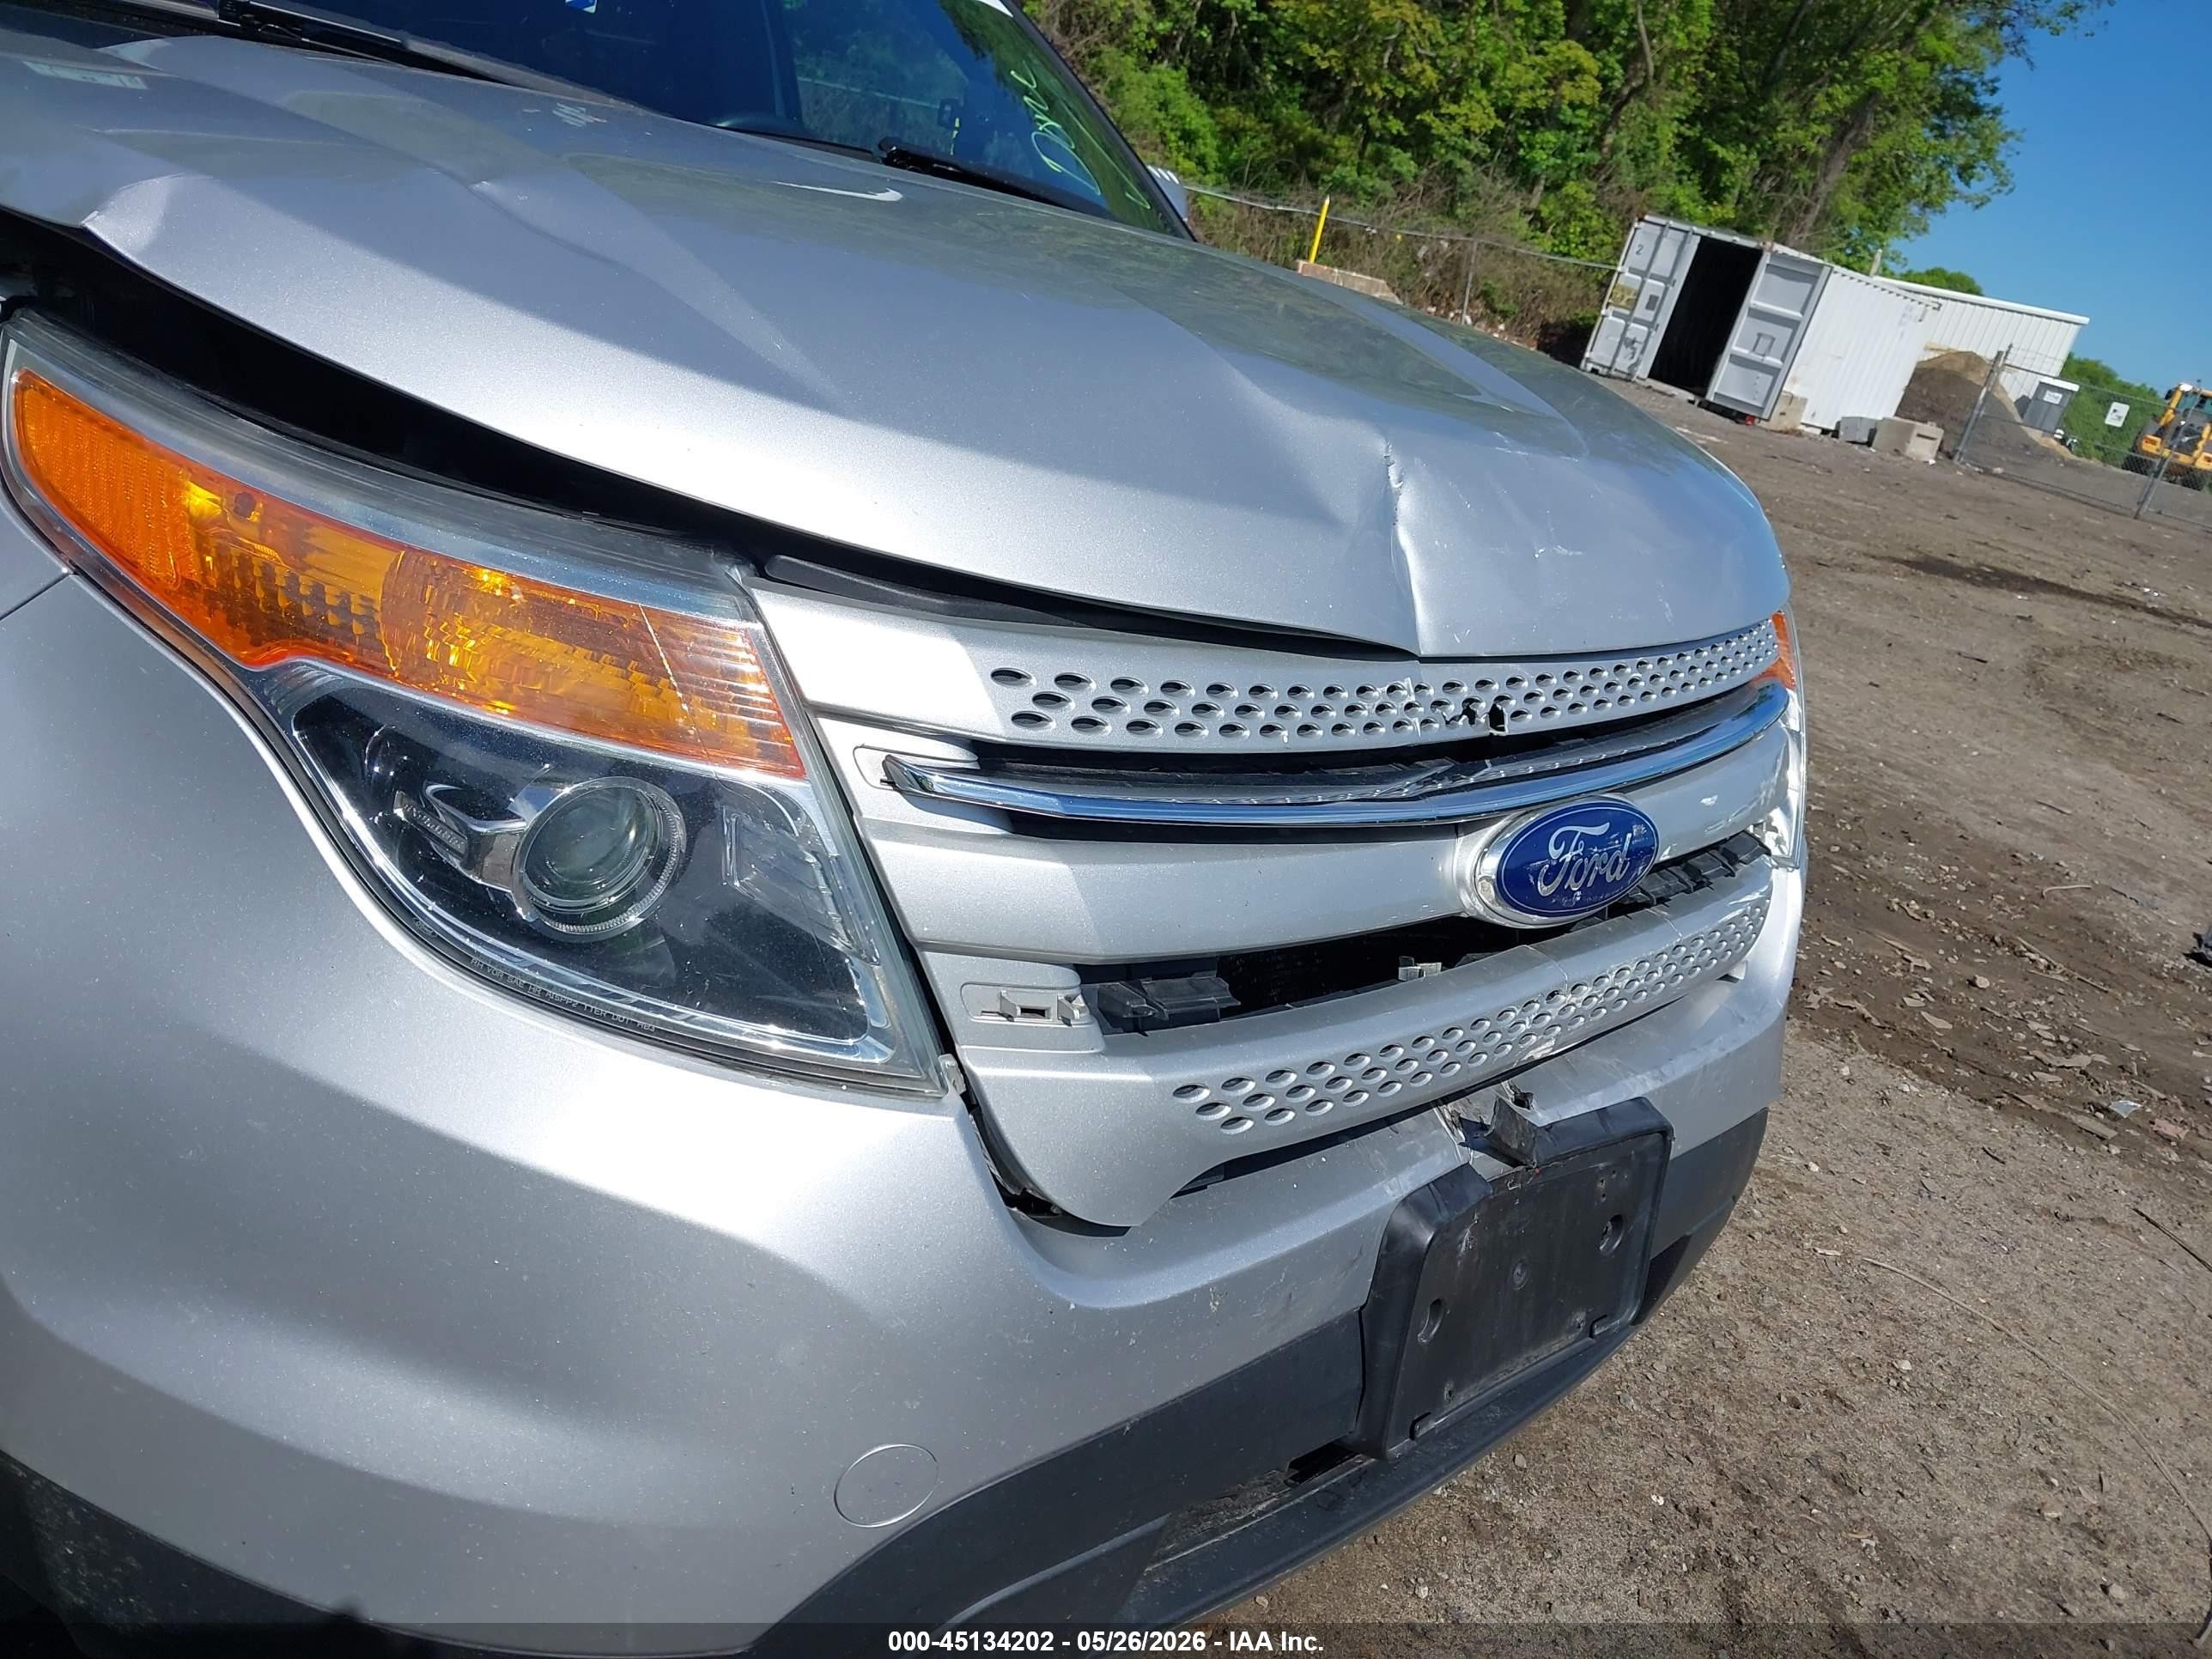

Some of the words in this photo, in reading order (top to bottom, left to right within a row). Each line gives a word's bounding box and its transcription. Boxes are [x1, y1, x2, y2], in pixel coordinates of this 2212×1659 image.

[1635, 243, 1644, 256] 2
[1537, 821, 1632, 897] Ford
[471, 957, 484, 969] RH
[487, 965, 504, 979] VOR
[507, 975, 525, 988] SAE
